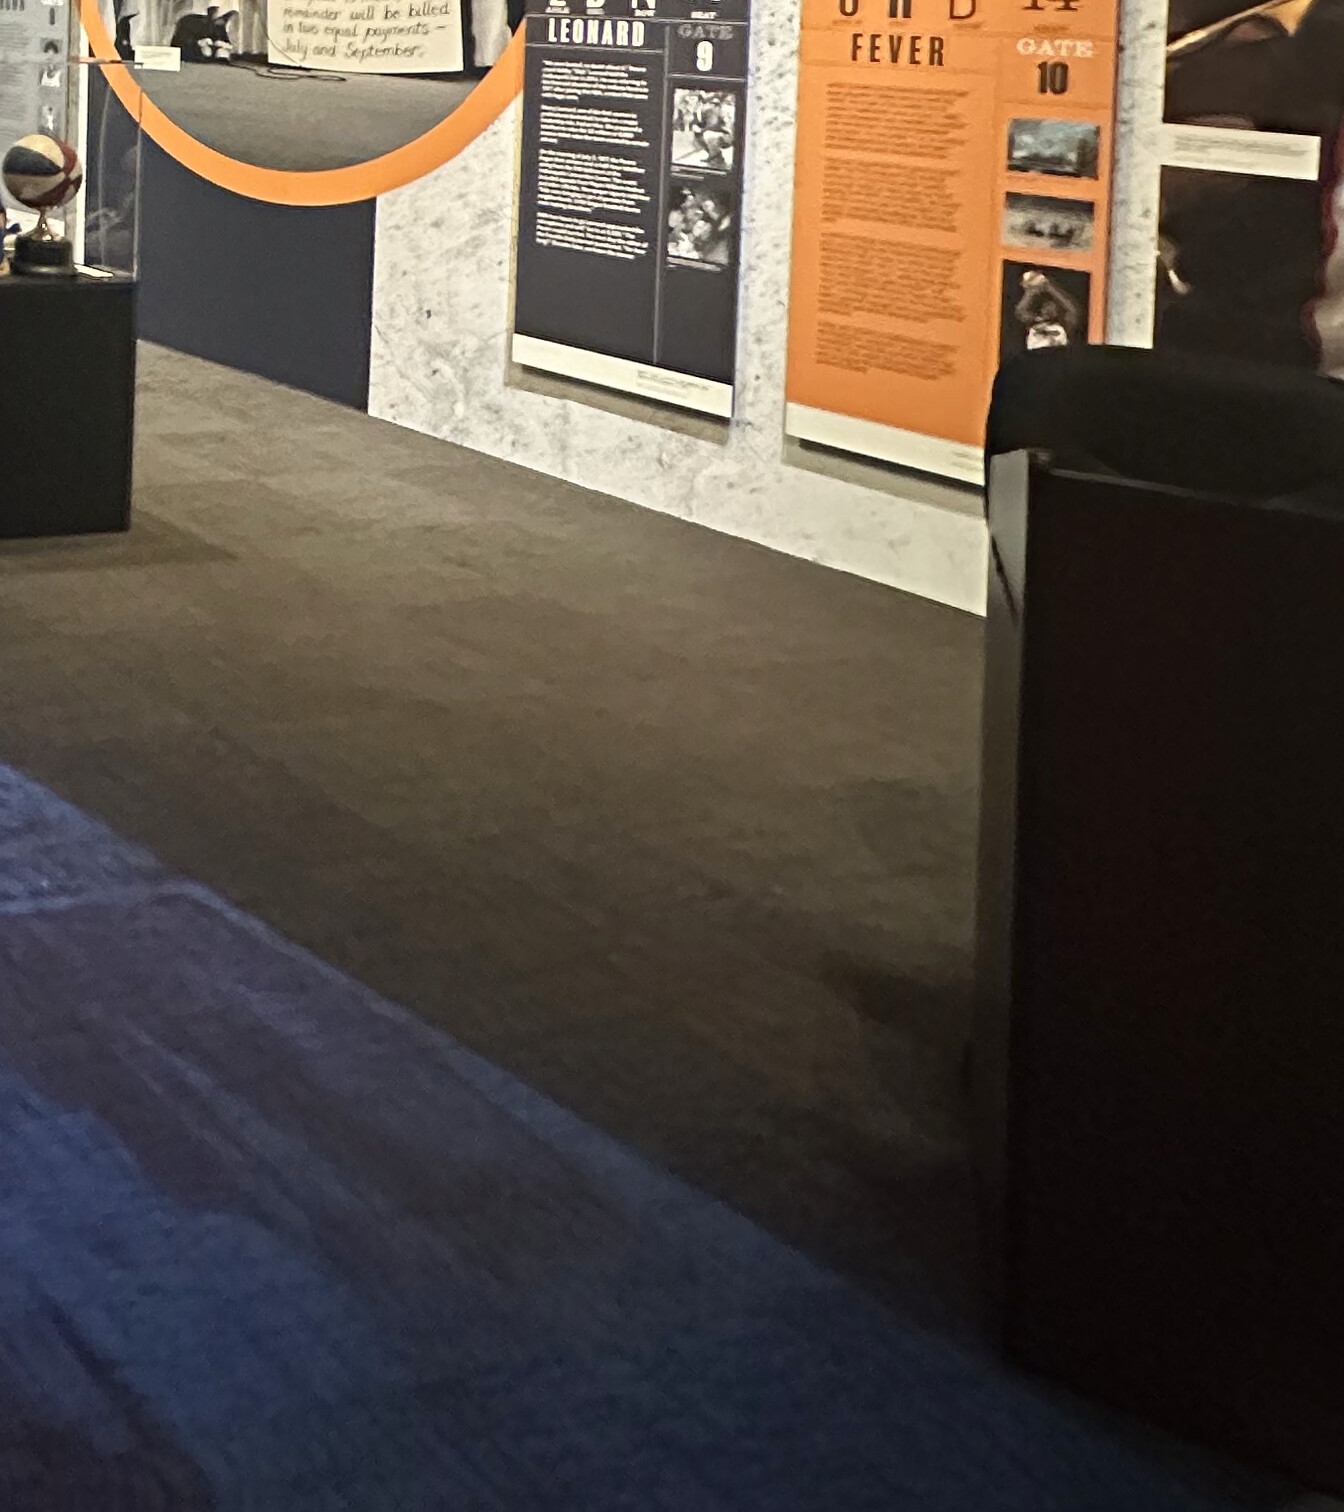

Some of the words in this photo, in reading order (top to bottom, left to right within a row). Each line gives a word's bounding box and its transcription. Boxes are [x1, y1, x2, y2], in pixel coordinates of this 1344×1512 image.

[350, 6, 375, 20] will
[384, 4, 399, 20] be
[408, 1, 450, 18] billed
[365, 21, 429, 43] payments
[548, 18, 645, 47] LEONARD
[677, 25, 735, 40] GATE
[313, 42, 336, 57] and
[696, 40, 713, 72] 9
[851, 33, 944, 66] FEVER
[1016, 38, 1094, 58] GATE
[1037, 61, 1068, 95] 10
